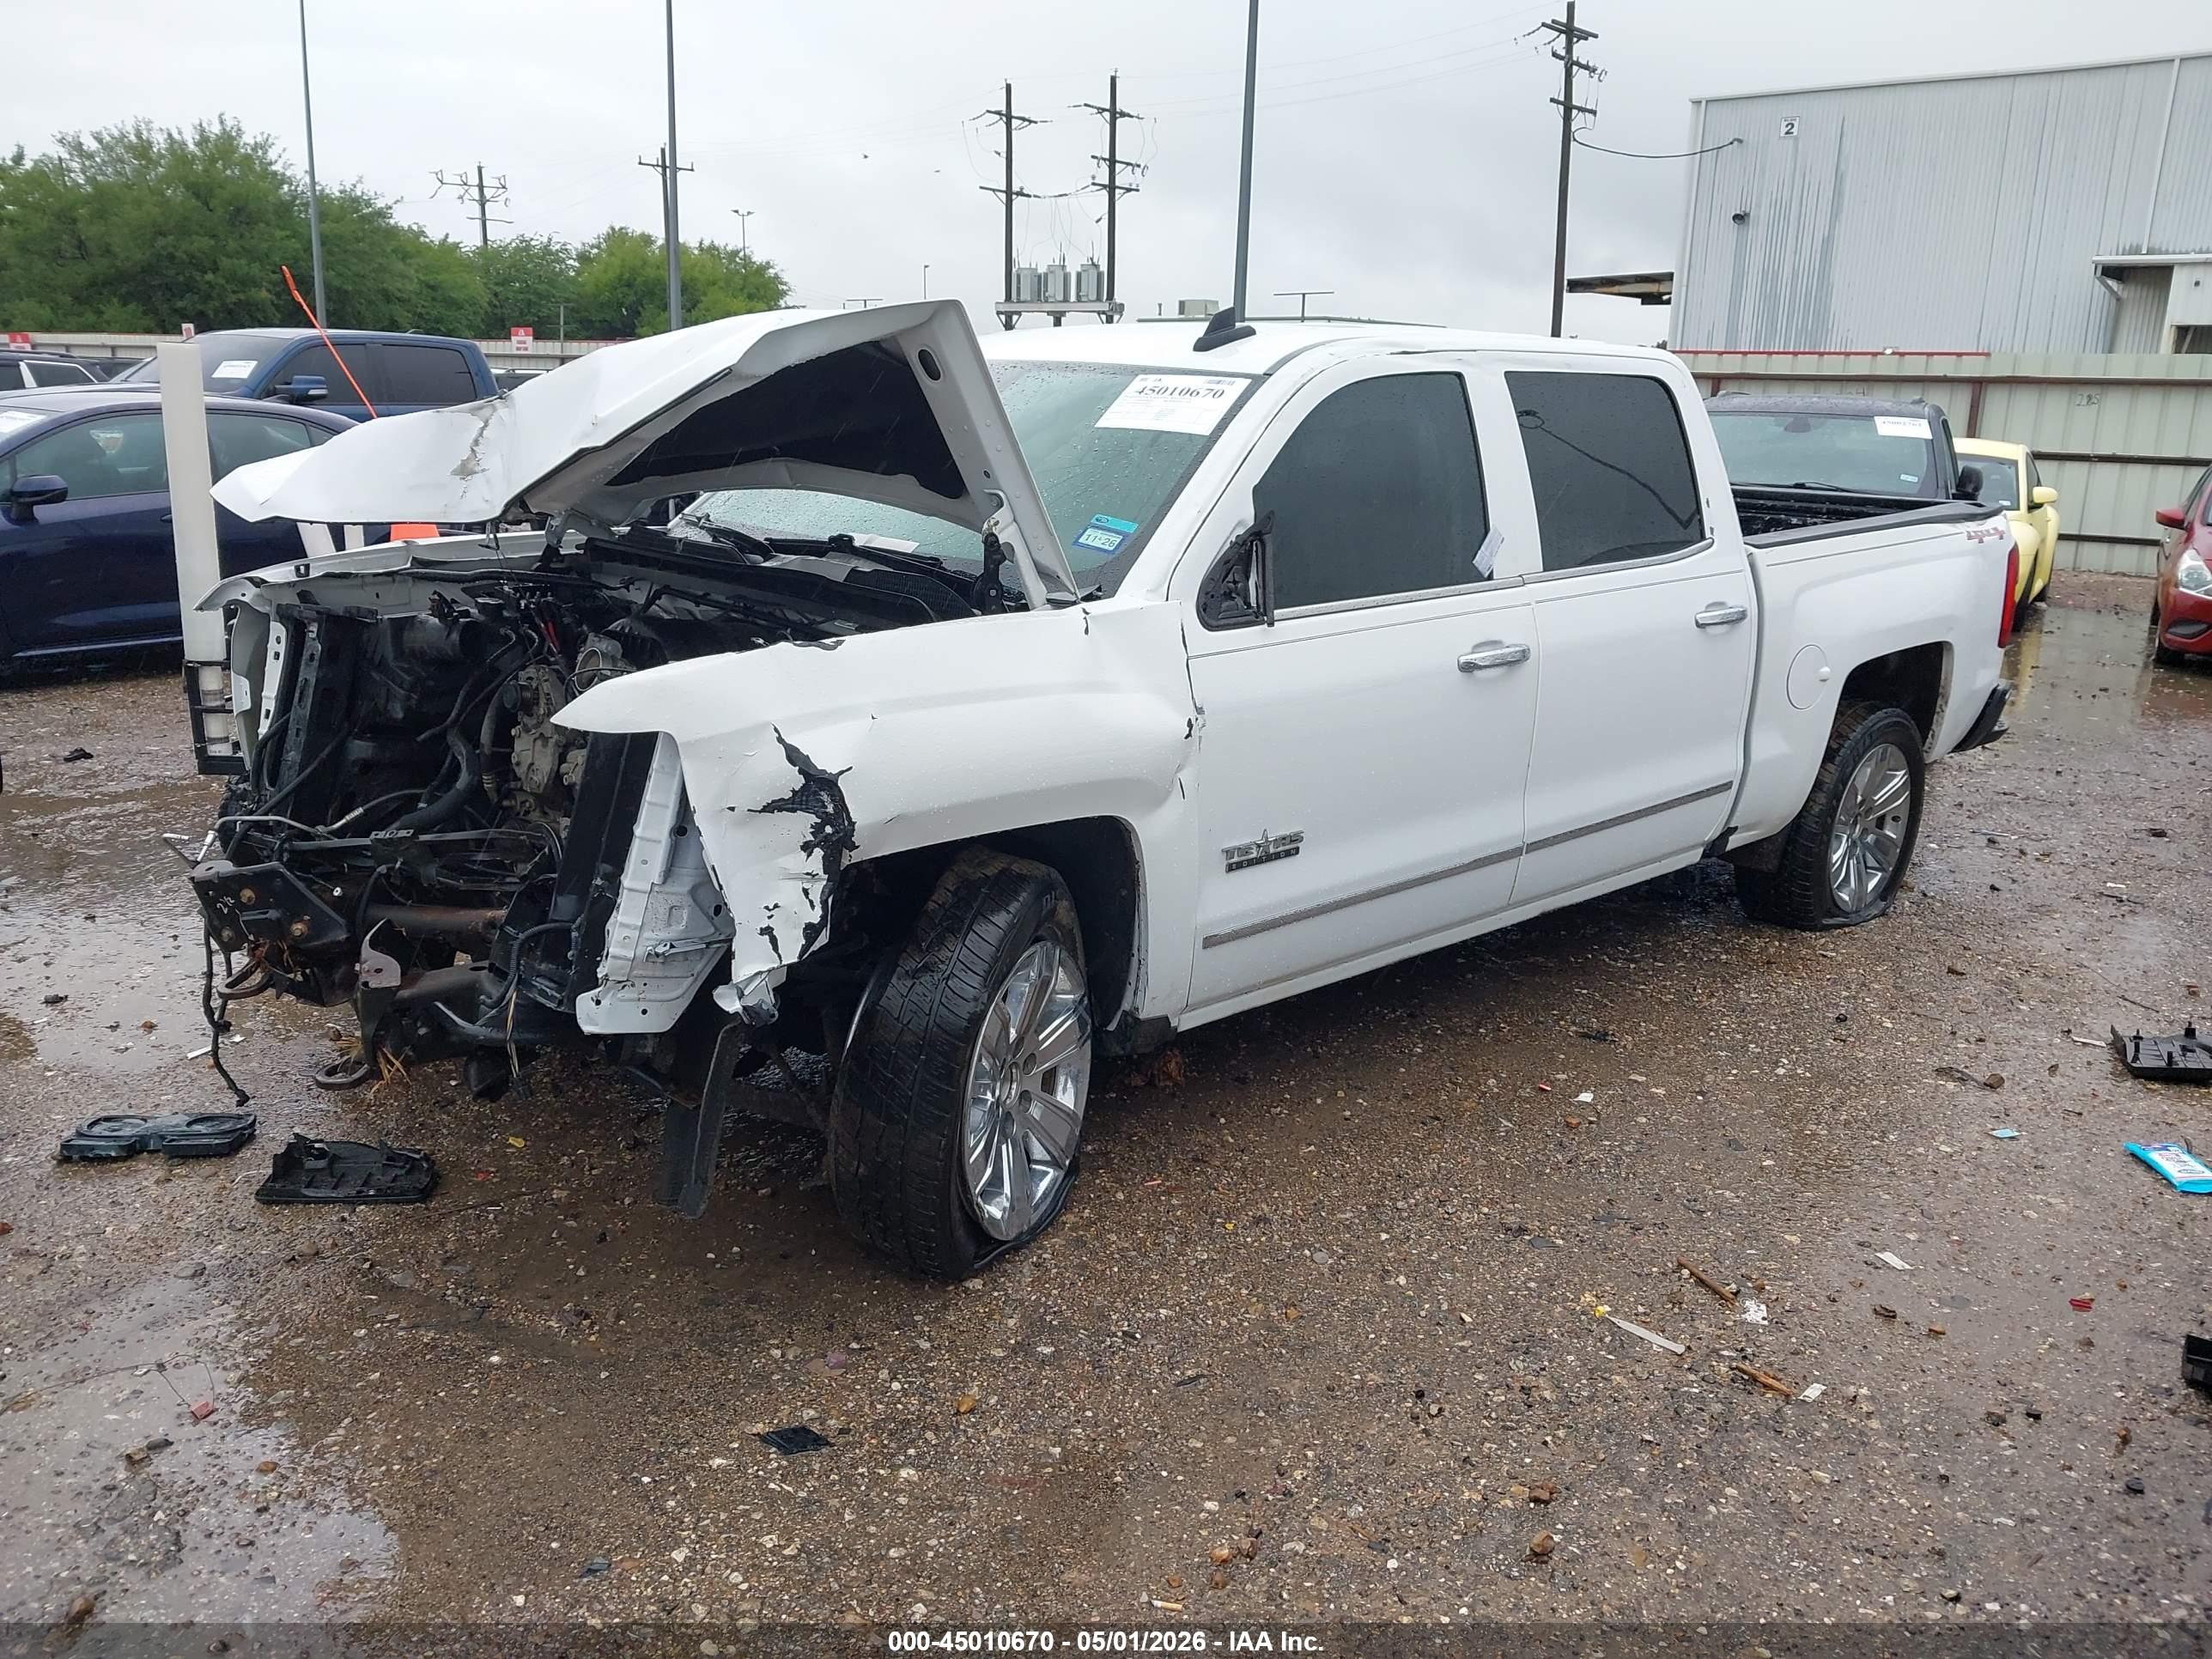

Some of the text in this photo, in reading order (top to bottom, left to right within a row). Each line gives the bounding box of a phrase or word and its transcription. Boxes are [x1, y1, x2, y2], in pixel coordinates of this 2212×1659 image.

[1784, 122, 1795, 136] 2
[1134, 385, 1226, 399] 45010670
[1230, 848, 1297, 871] EDITION
